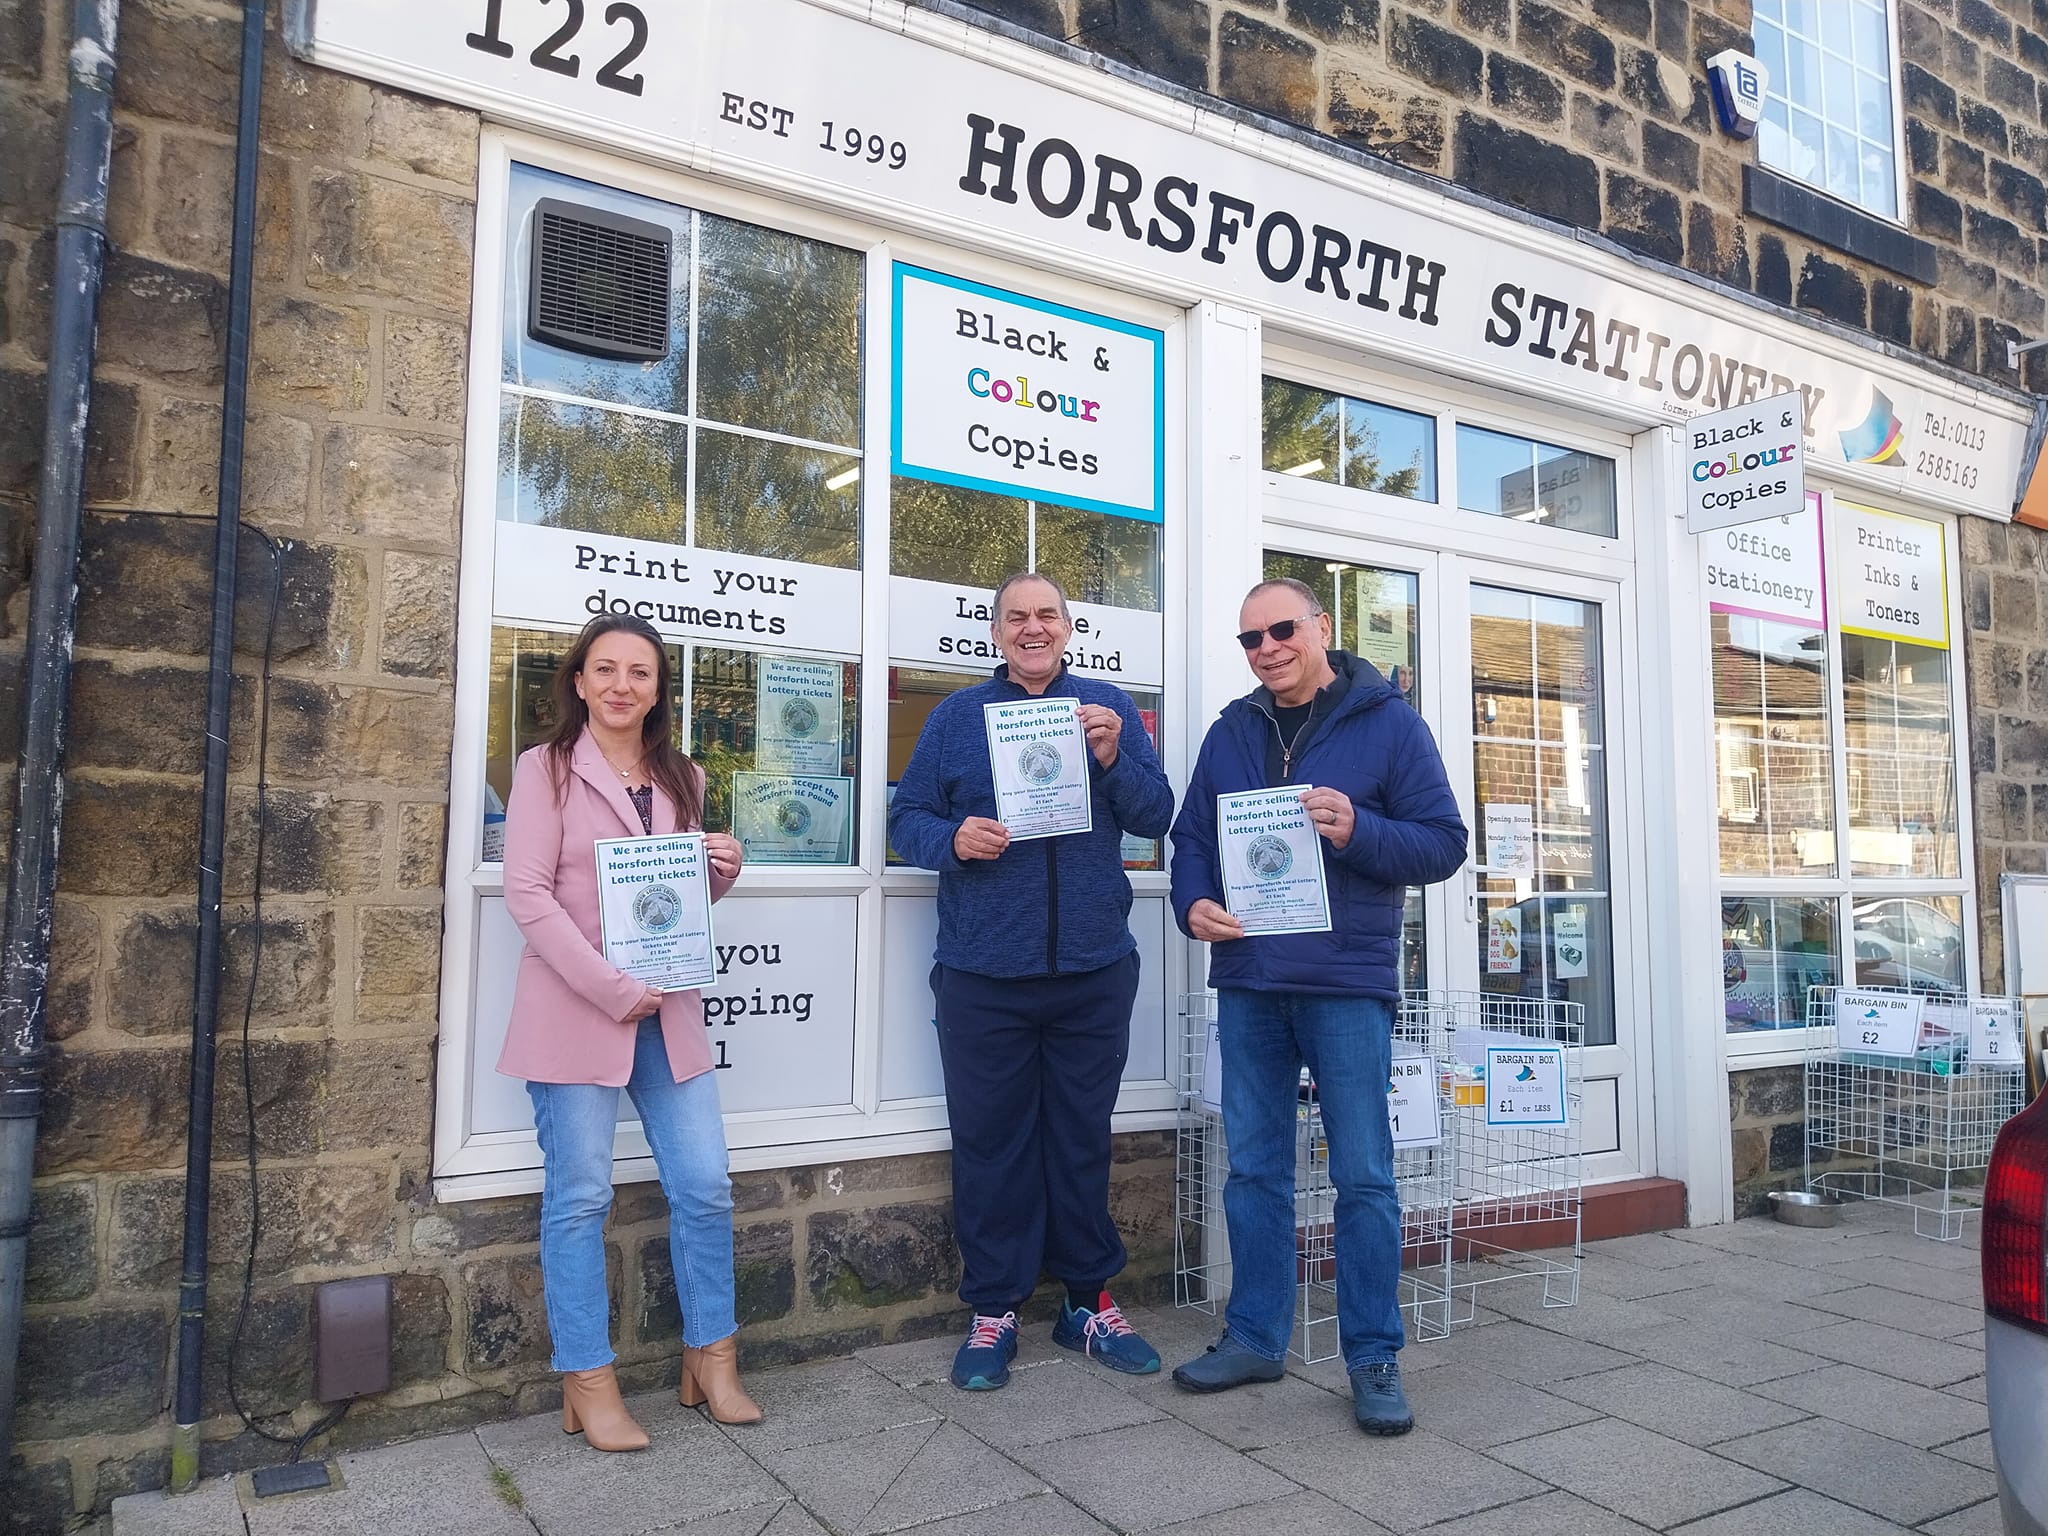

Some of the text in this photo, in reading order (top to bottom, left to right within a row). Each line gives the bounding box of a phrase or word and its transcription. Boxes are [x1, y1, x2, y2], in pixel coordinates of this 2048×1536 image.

[466, 0, 649, 97] 122
[719, 92, 908, 170] EST 1999
[959, 113, 1447, 326] HORSFORTH
[956, 308, 1110, 372] Black &
[968, 368, 1100, 423] Colour
[1693, 411, 1793, 450] Black &
[1924, 412, 1985, 452] Tel:0113
[968, 424, 1099, 475] Copies
[1692, 443, 1797, 482] Colour
[1916, 451, 1978, 489] 2585163
[1702, 479, 1787, 510] Copies
[1726, 531, 1791, 562] Office
[1858, 527, 1921, 557] Printer
[575, 545, 798, 596] Print your
[1864, 564, 1919, 591] Inks &
[1707, 565, 1814, 608] Stationery
[585, 589, 786, 635] documents
[1866, 599, 1920, 625] Toners
[771, 663, 784, 671] We
[804, 667, 833, 676] selling
[766, 674, 834, 687] Horsforth Local
[768, 686, 833, 698] Lottery tickets
[1037, 704, 1070, 714] selling
[996, 715, 1074, 730] Horsforth Local
[1000, 729, 1074, 743] Lottery tickets
[744, 781, 775, 799] Happy
[792, 779, 823, 792] accept
[825, 786, 839, 800] the
[808, 792, 833, 807] Pound
[1231, 800, 1244, 808] We
[1265, 794, 1299, 804] selling
[1226, 806, 1304, 821] Horsforth Local
[1487, 815, 1531, 824] Opening Hours
[1228, 821, 1304, 835] Lottery tickets
[1488, 834, 1506, 842] Monday
[1514, 834, 1531, 842] Friday
[613, 841, 693, 855] We are selling
[608, 854, 696, 870] Horsforth Local
[611, 869, 696, 885] Lottery tickets
[716, 943, 781, 971] you
[1490, 950, 1500, 958] DOG
[1844, 997, 1908, 1010] BARGAIN BIN
[1975, 1007, 2008, 1016] BARGAIN BIN
[1857, 1019, 1873, 1027] Each
[1862, 1032, 1879, 1044] £2
[1989, 1041, 1998, 1054] £2
[1497, 1055, 1554, 1064] BARGAIN BOX
[1407, 1065, 1422, 1076] BIN
[1507, 1085, 1543, 1093] Each item
[1500, 1100, 1514, 1112] £1
[1388, 1114, 1400, 1132] 1
